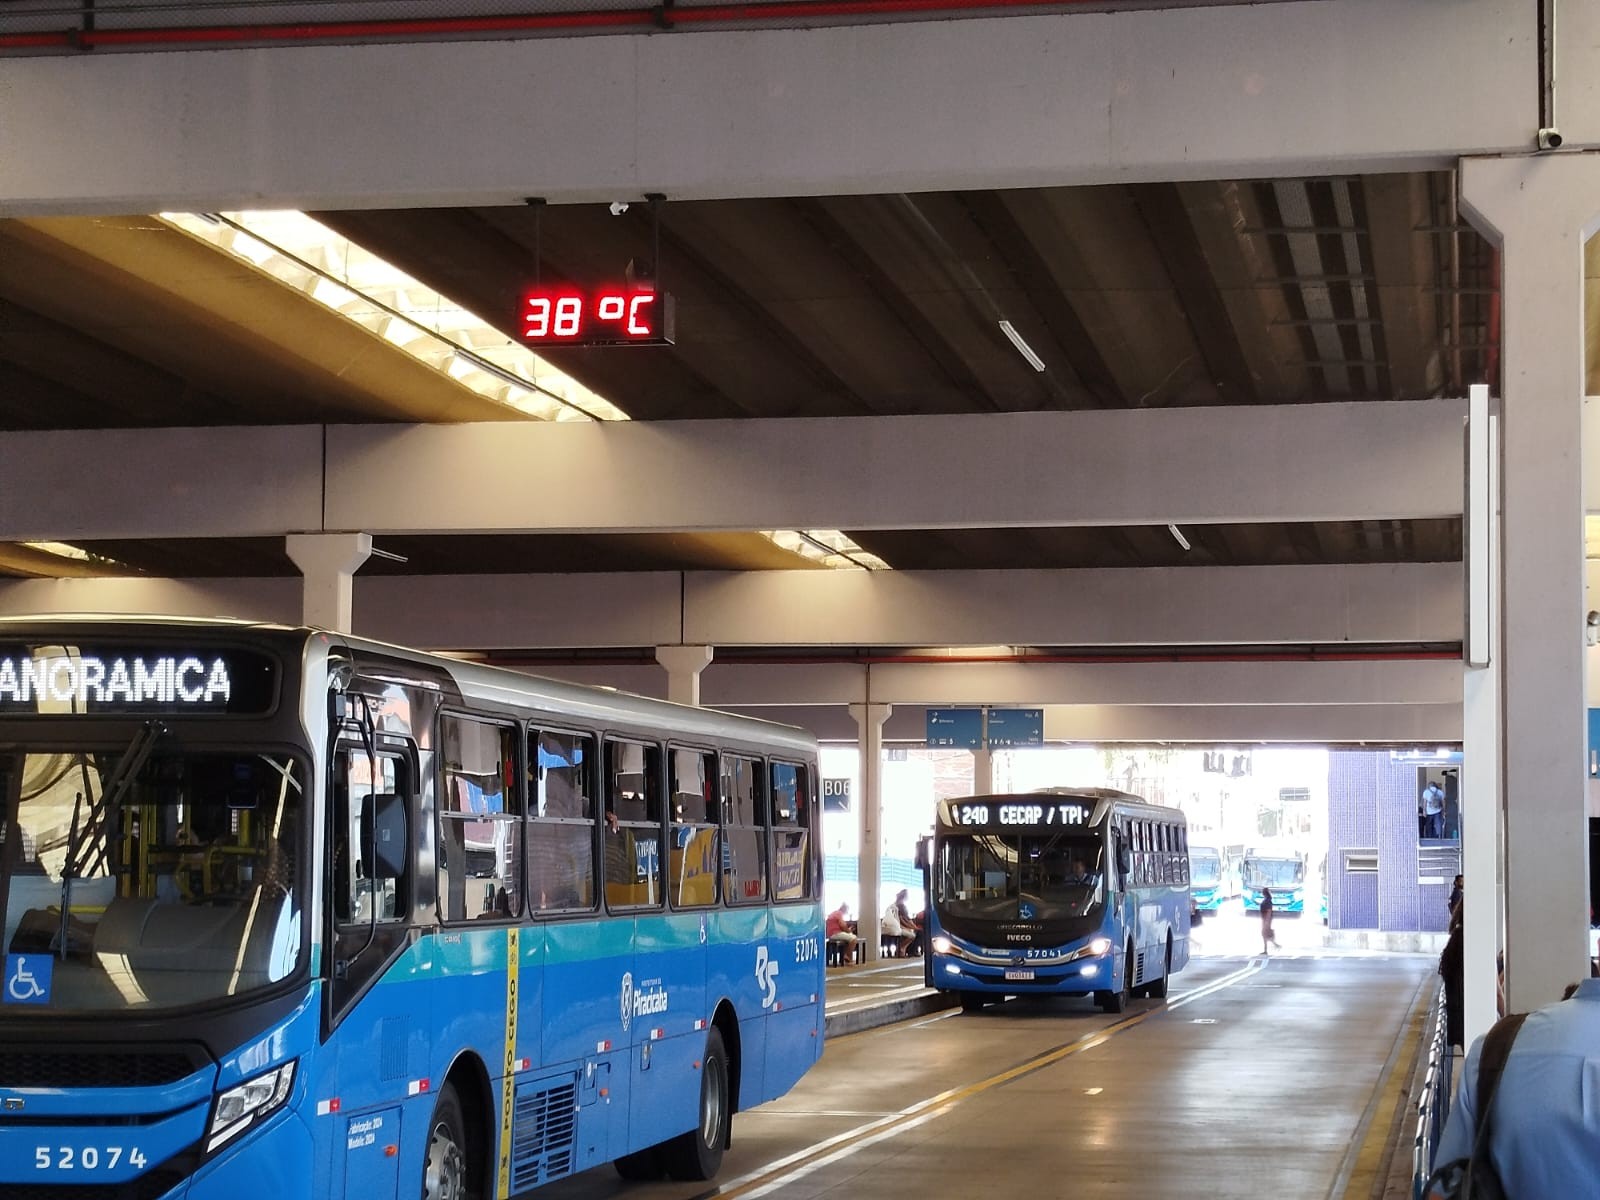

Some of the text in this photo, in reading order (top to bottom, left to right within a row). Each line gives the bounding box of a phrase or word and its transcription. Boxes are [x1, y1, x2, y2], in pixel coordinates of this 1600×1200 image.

[526, 297, 582, 336] 38
[0, 657, 230, 702] ANORAMICA
[962, 805, 988, 825] 240
[1000, 805, 1043, 825] CECAP
[1059, 805, 1083, 825] TPI
[795, 938, 819, 963] 52074
[633, 985, 668, 1017] Piracicaba
[504, 1050, 513, 1130] PONTO
[35, 1147, 147, 1169] 52074
